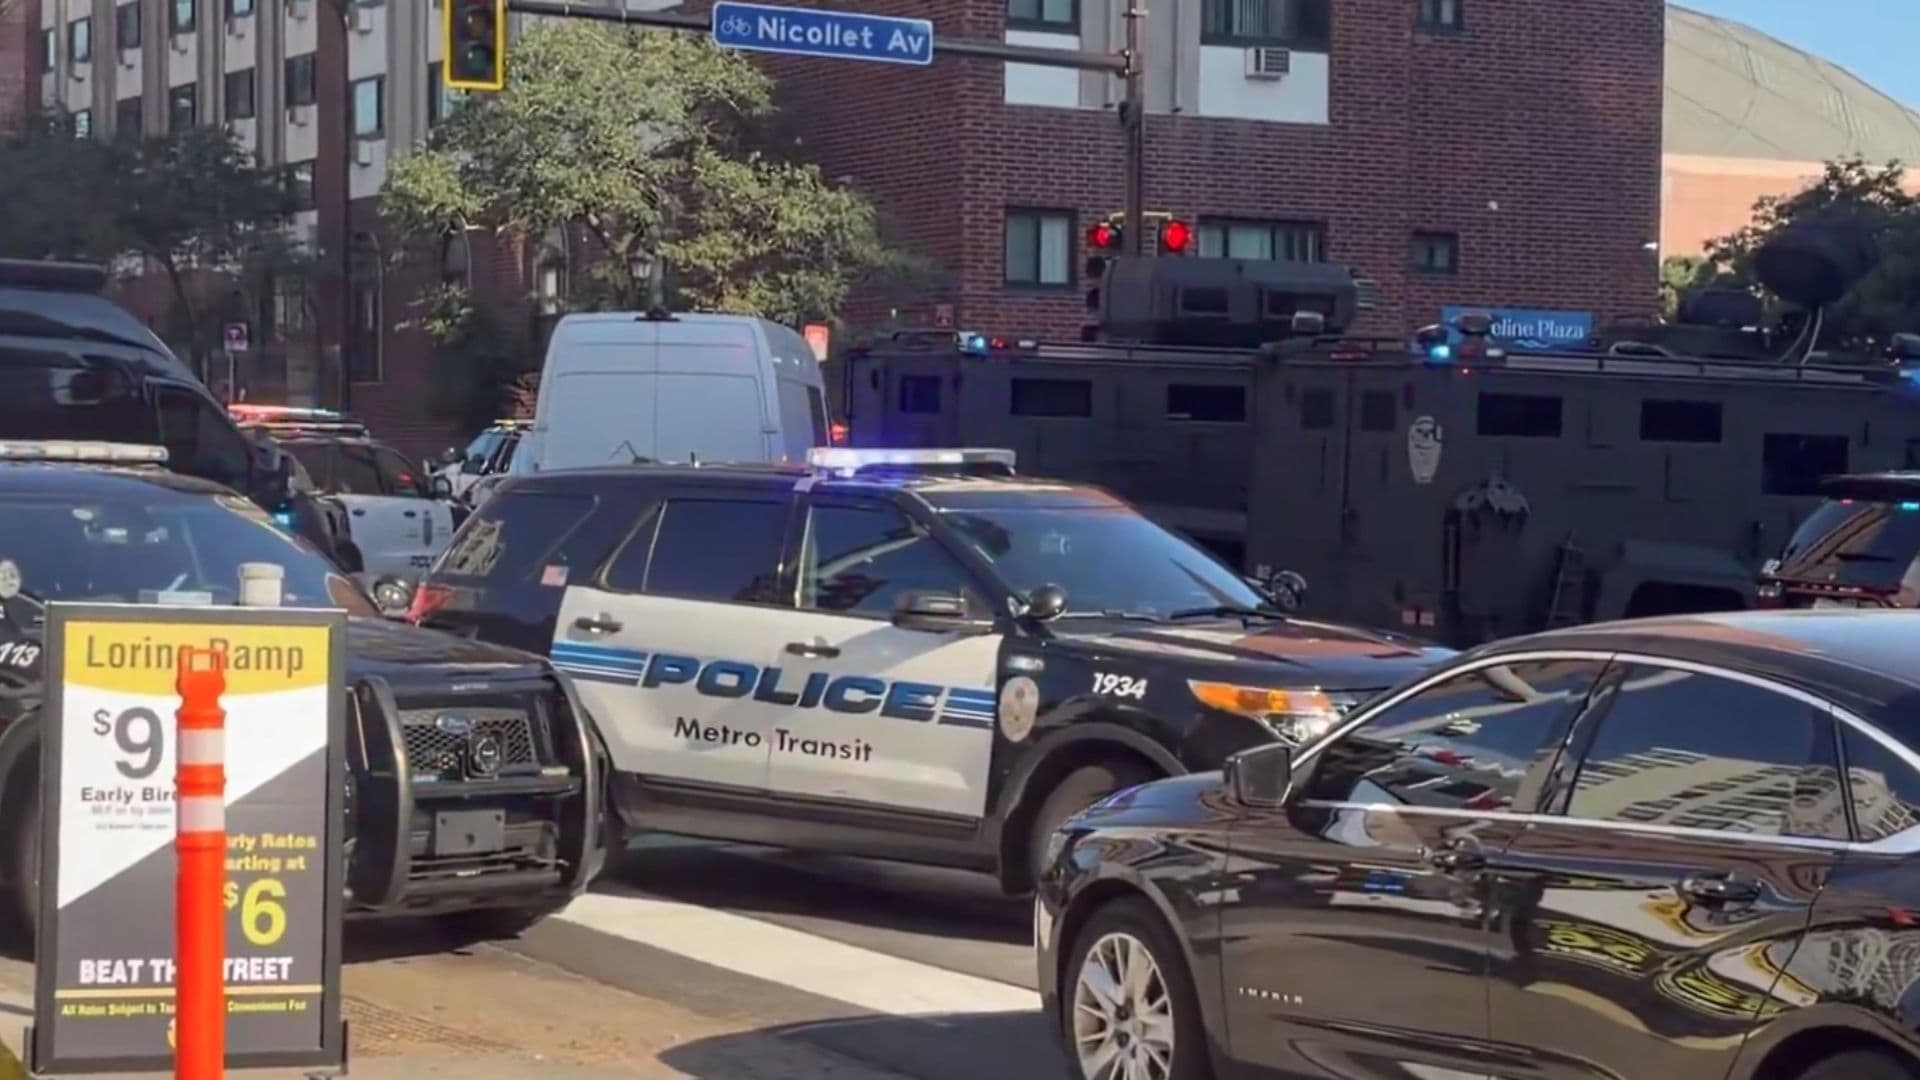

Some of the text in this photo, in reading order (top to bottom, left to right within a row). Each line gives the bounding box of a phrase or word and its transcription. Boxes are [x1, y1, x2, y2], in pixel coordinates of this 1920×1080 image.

[757, 15, 924, 54] Nicollet Av
[1537, 319, 1584, 339] Plaza
[86, 635, 303, 678] Lorin Ramp
[642, 653, 946, 722] POLICE
[1092, 671, 1148, 699] 1934
[673, 716, 873, 763] Metro Transit
[81, 786, 134, 805] Early
[261, 833, 317, 849] Rates
[224, 855, 306, 874] arting at
[79, 957, 293, 984] BEAT TH TREET
